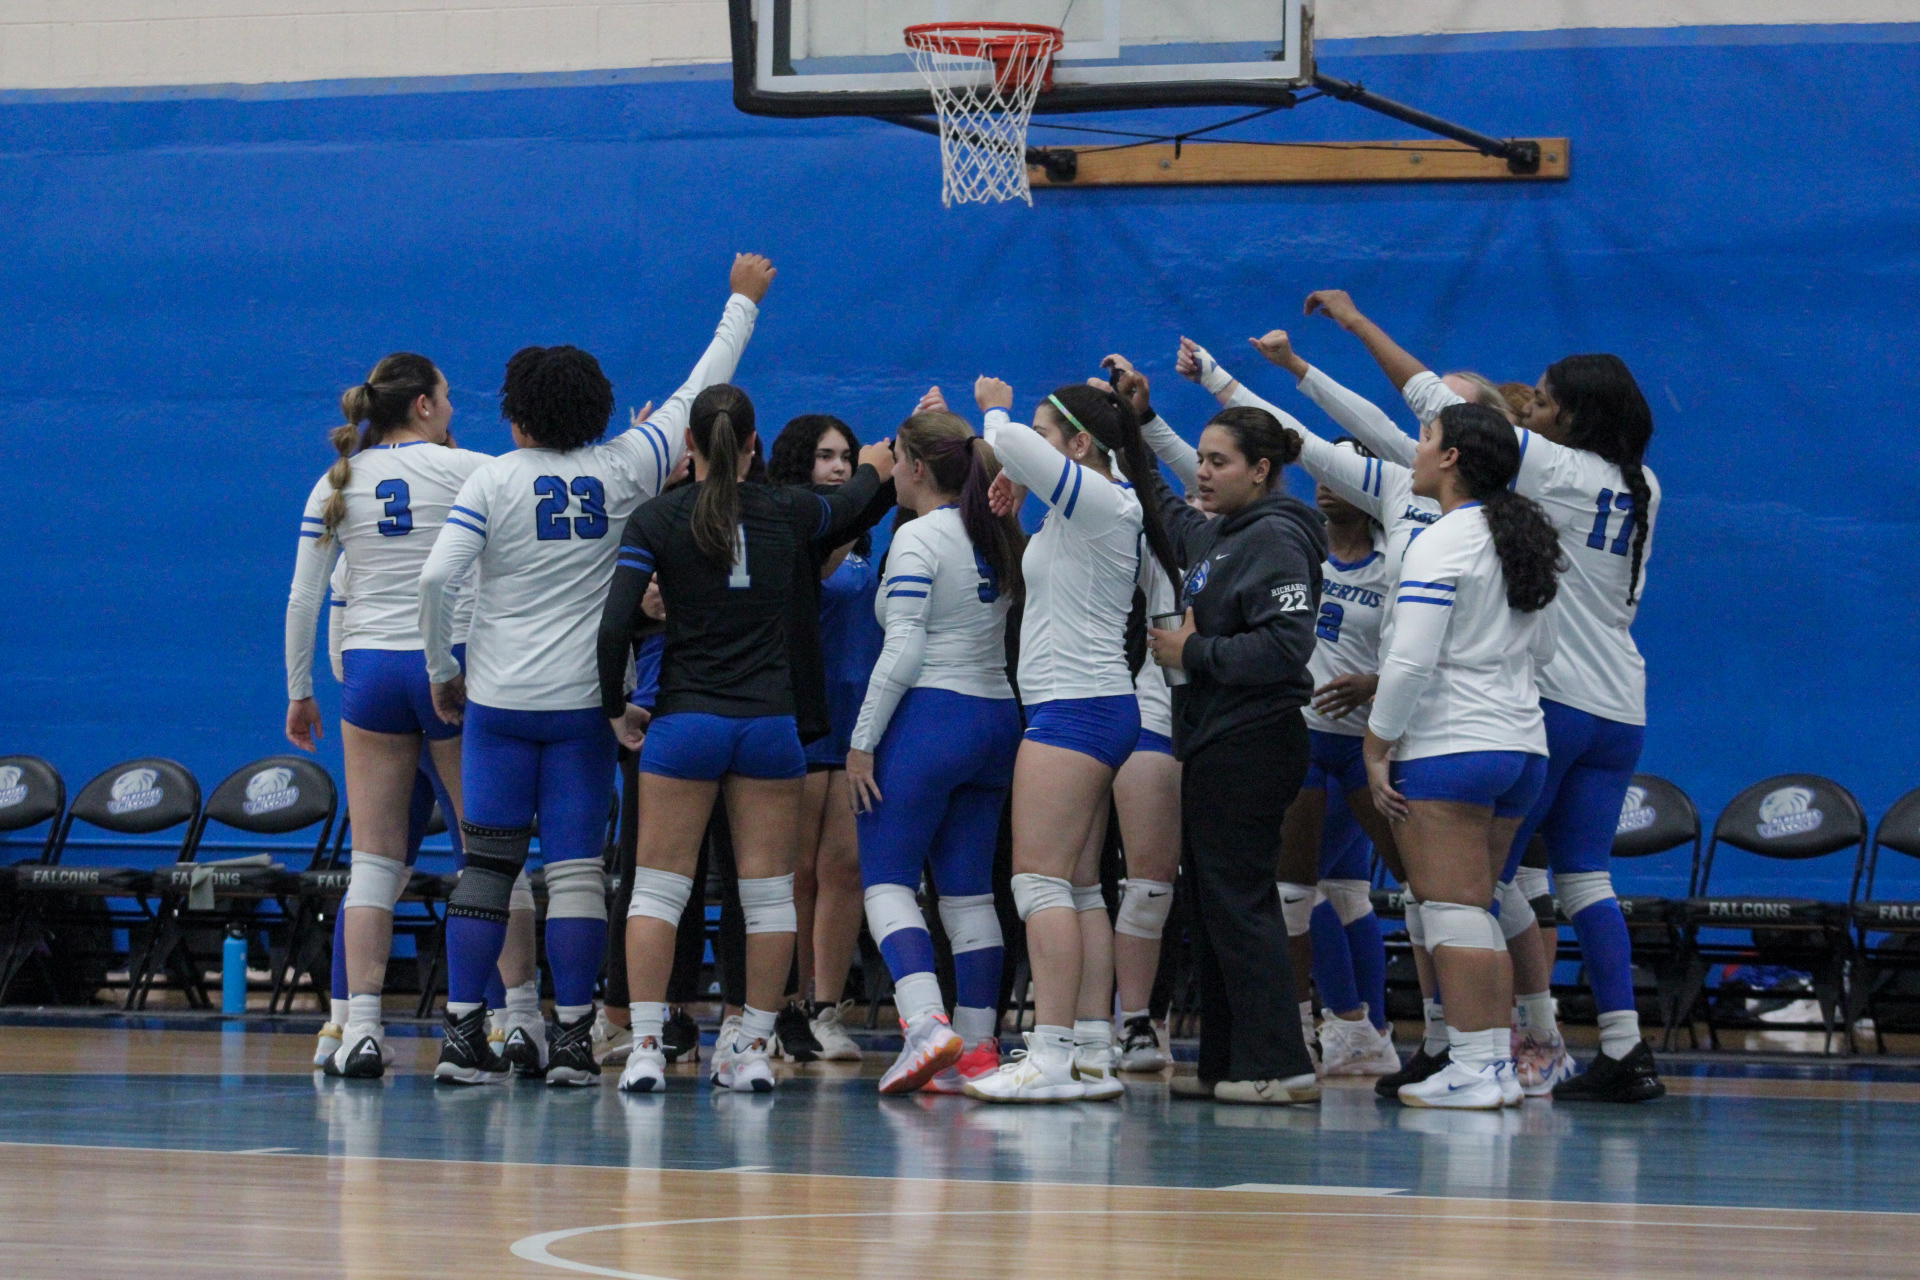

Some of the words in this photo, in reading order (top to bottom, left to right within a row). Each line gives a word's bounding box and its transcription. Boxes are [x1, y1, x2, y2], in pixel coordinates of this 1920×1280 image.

[375, 478, 413, 537] 3
[533, 475, 609, 541] 23
[1586, 488, 1636, 557] 17
[728, 523, 751, 588] 1
[1279, 591, 1309, 612] 22
[1322, 578, 1383, 608] BERTUS
[1316, 601, 1344, 642] 2
[33, 870, 99, 884] FALCONS
[172, 871, 241, 886] FAONS
[318, 874, 351, 888] FALC
[1709, 901, 1791, 918] FALCONS
[1880, 905, 1920, 920] FALC
